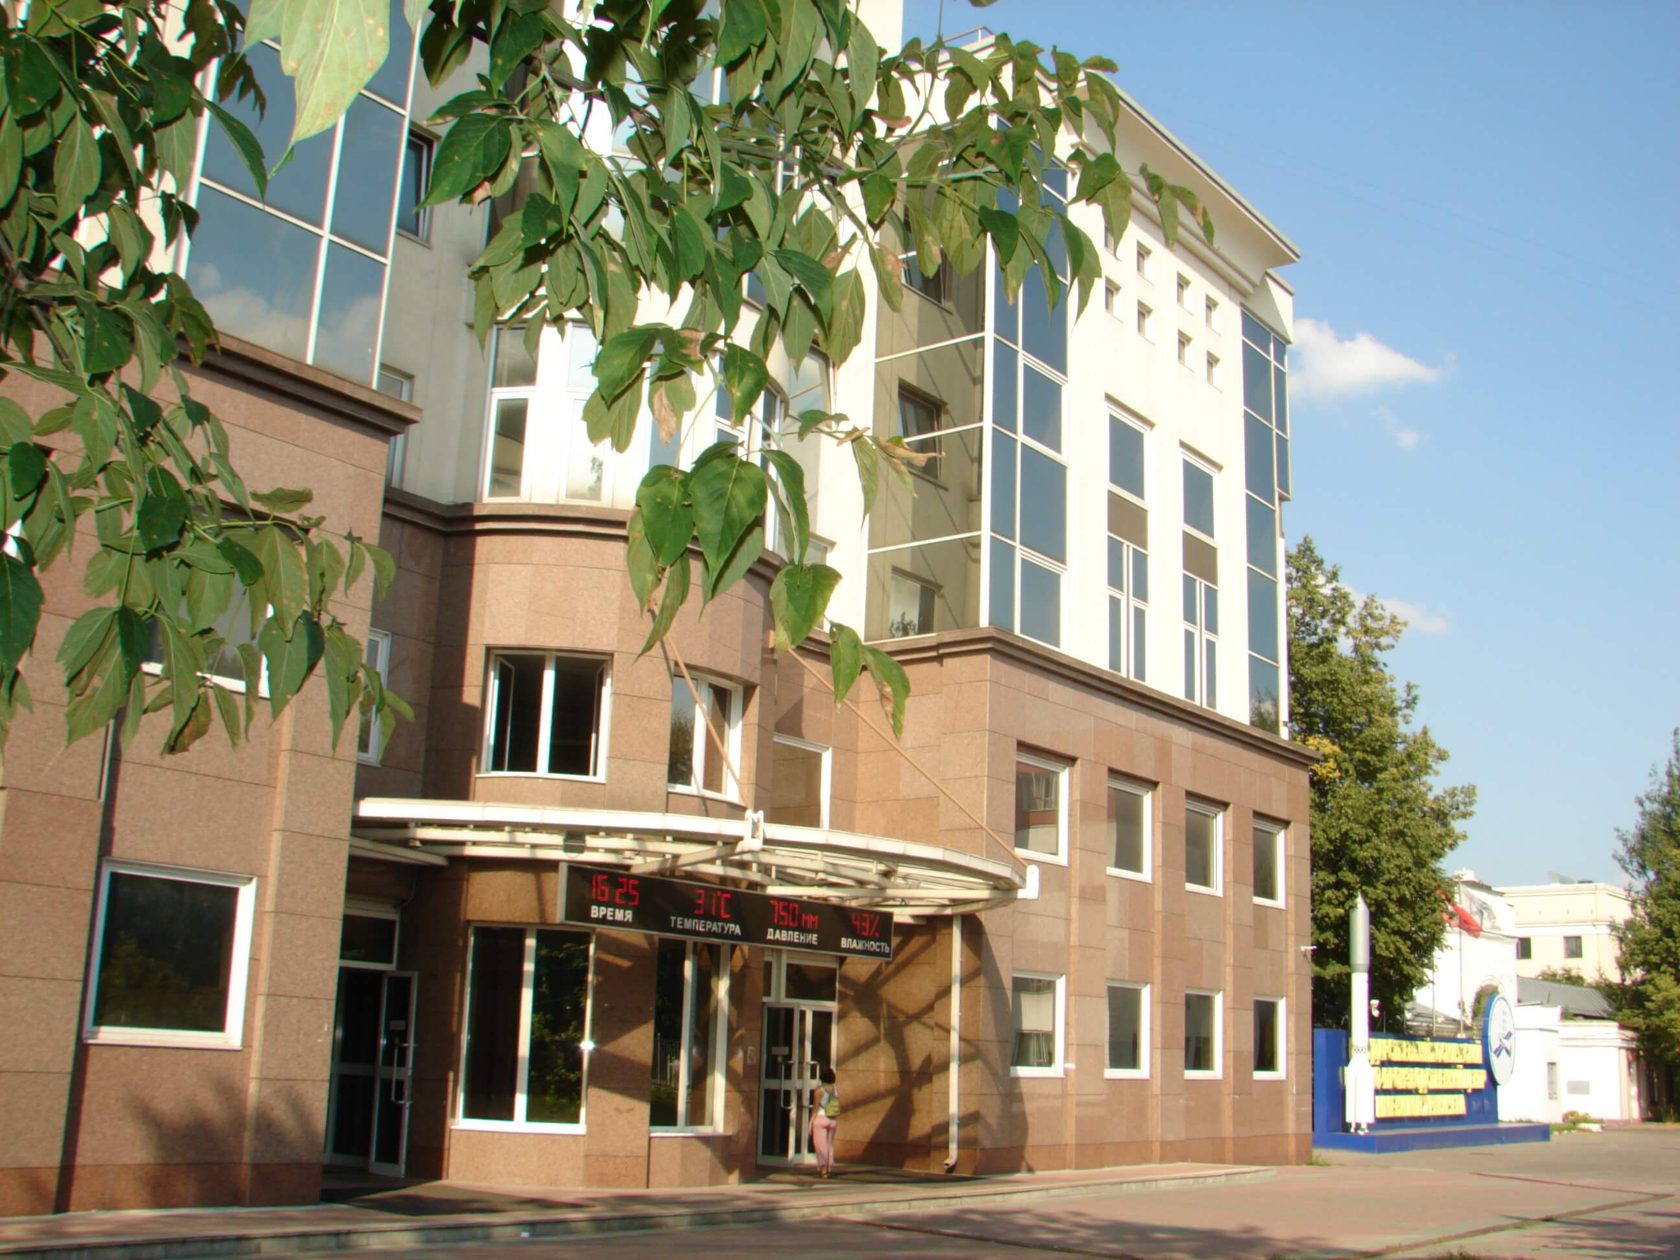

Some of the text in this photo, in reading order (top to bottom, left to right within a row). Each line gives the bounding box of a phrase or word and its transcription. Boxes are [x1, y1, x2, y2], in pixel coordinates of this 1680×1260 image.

[591, 874, 640, 907] 16 25
[590, 904, 633, 923] ВРЕМЯ
[669, 915, 742, 936] ТЕМПЕРАТУРА
[766, 927, 819, 945] ДАВЛЕНИЕ
[840, 936, 890, 954] ВЛАЖНОСТЬ
